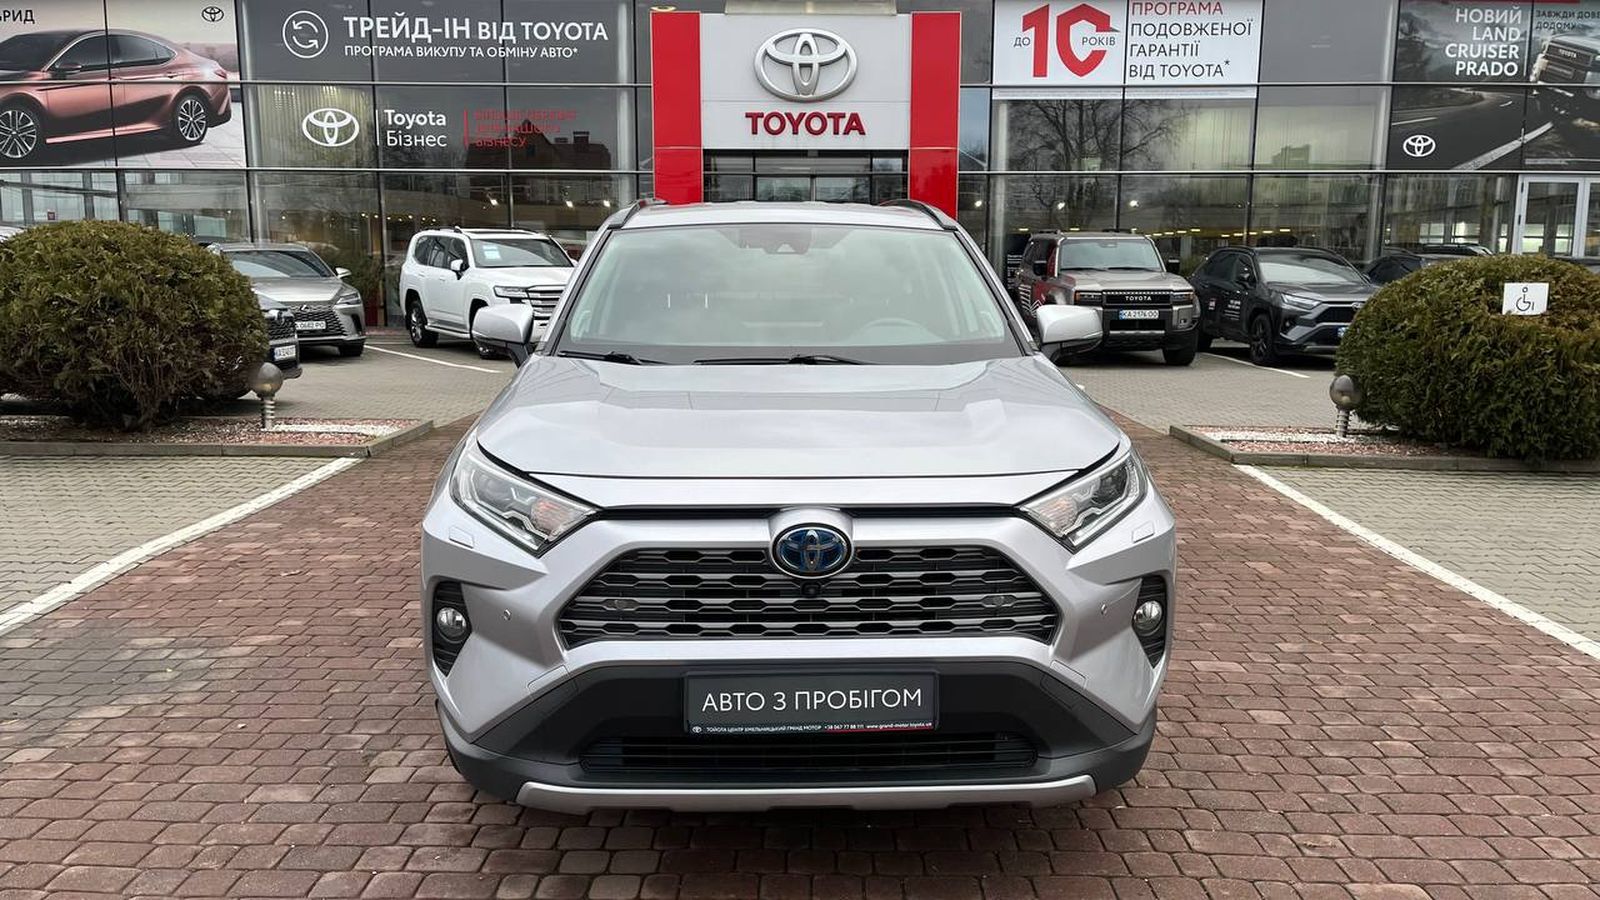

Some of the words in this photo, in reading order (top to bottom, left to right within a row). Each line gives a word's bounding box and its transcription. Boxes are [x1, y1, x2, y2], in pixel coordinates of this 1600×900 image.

[0, 9, 35, 24] РИД
[1132, 1, 1223, 16] ПРОГРАМА
[1456, 6, 1522, 24] НОВИЙ
[343, 12, 471, 43] ТРЕЙД-ІН
[478, 22, 516, 44] ВІД
[520, 22, 609, 41] TOYOTA
[1131, 19, 1253, 39] ПОДОВЖЕНОЇ
[1473, 27, 1521, 42] LAND
[1014, 37, 1031, 47] ДО
[1082, 37, 1116, 46] РОКІВ
[1129, 40, 1201, 57] ГАРАНТІЇ
[345, 45, 413, 57] ПРОГРАМА
[416, 46, 467, 58] ВИКУПУ
[469, 47, 484, 57] ТА
[487, 47, 538, 58] ОБМІНУ
[1445, 43, 1519, 59] CRUISER
[1129, 64, 1155, 80] ВІД
[1455, 61, 1518, 76] PRADO
[384, 109, 447, 129] Toyota
[745, 112, 866, 135] TOYOTA
[387, 130, 448, 147] Бізнес
[702, 692, 765, 711] АВТО
[795, 688, 921, 710] ПРОБІГОМ
